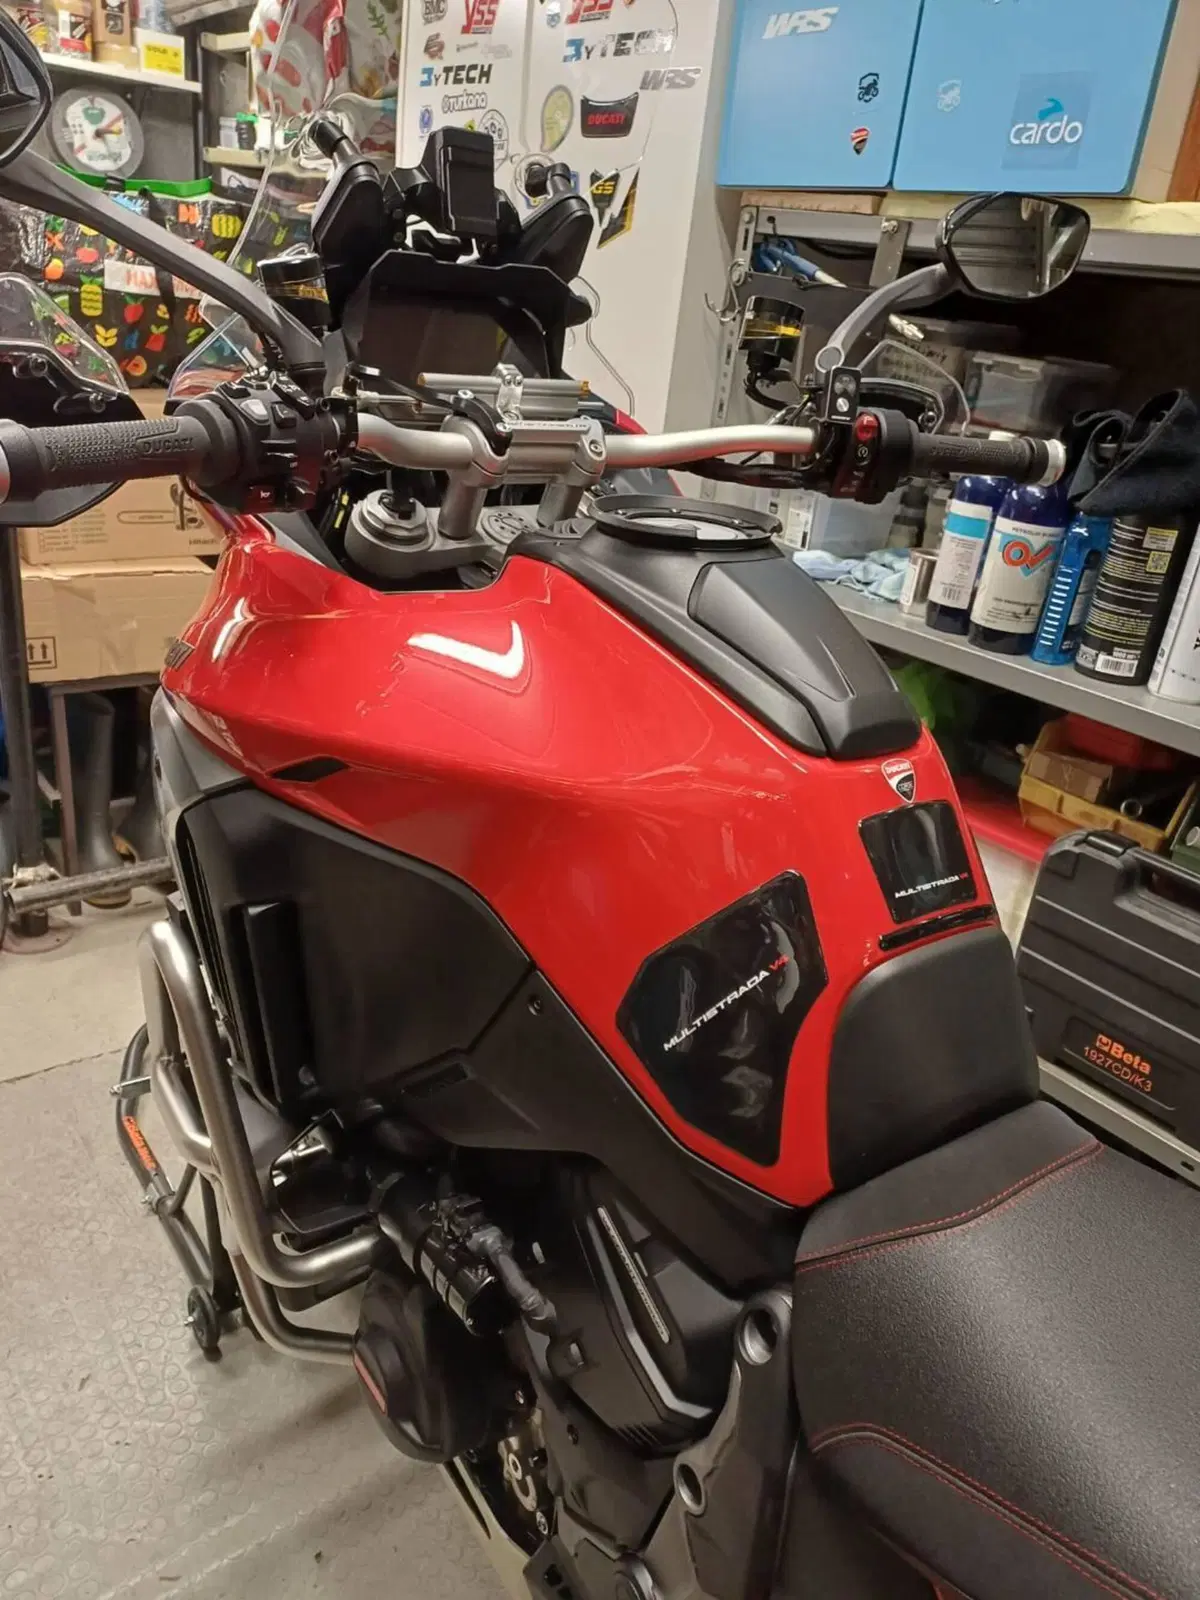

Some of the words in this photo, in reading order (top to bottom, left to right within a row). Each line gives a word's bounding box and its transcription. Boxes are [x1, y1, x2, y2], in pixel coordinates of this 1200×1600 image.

[1009, 114, 1083, 145] cardo
[142, 437, 195, 455] DUCATI
[894, 875, 960, 899] MULTISTRADA
[663, 970, 771, 1052] MULTISTRADA
[769, 953, 790, 971] V4
[1110, 1041, 1152, 1075] Beta
